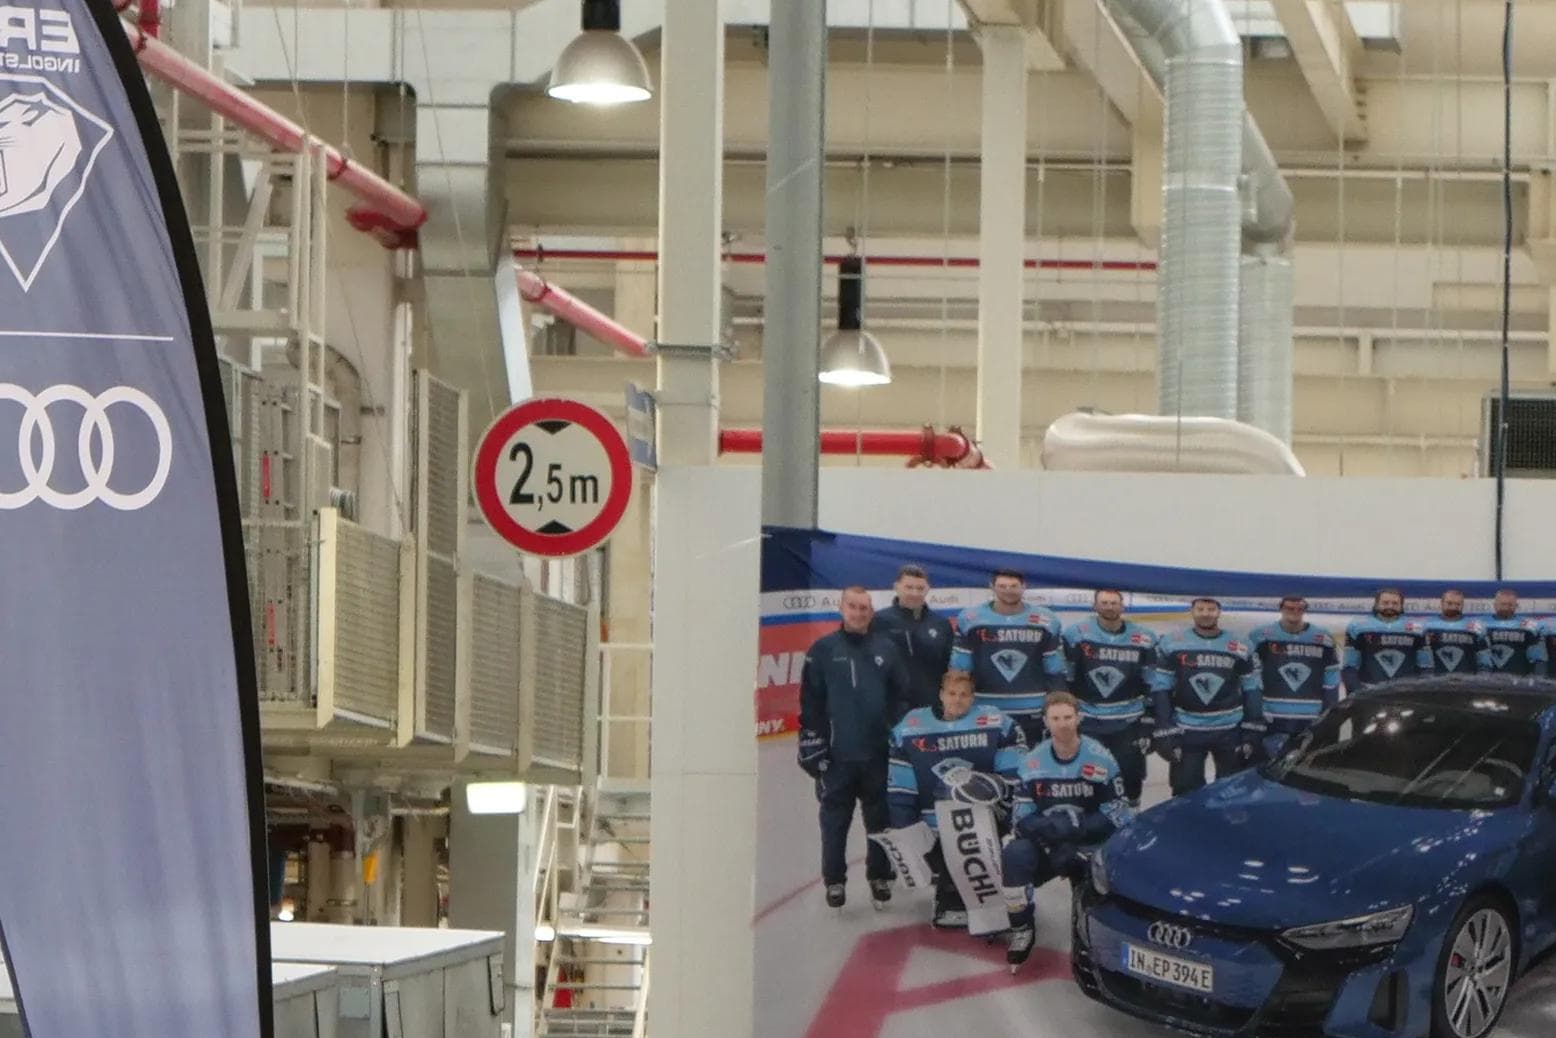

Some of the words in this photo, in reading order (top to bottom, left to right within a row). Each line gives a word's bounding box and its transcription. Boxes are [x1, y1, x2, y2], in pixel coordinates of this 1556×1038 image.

[997, 629, 1043, 643] SATURN
[1099, 649, 1140, 662] SATURN
[1286, 644, 1324, 658] SATURN
[1196, 654, 1236, 669] SATURN
[937, 732, 988, 751] SATURN
[1051, 782, 1094, 798] SATURN
[1131, 949, 1145, 971] IN
